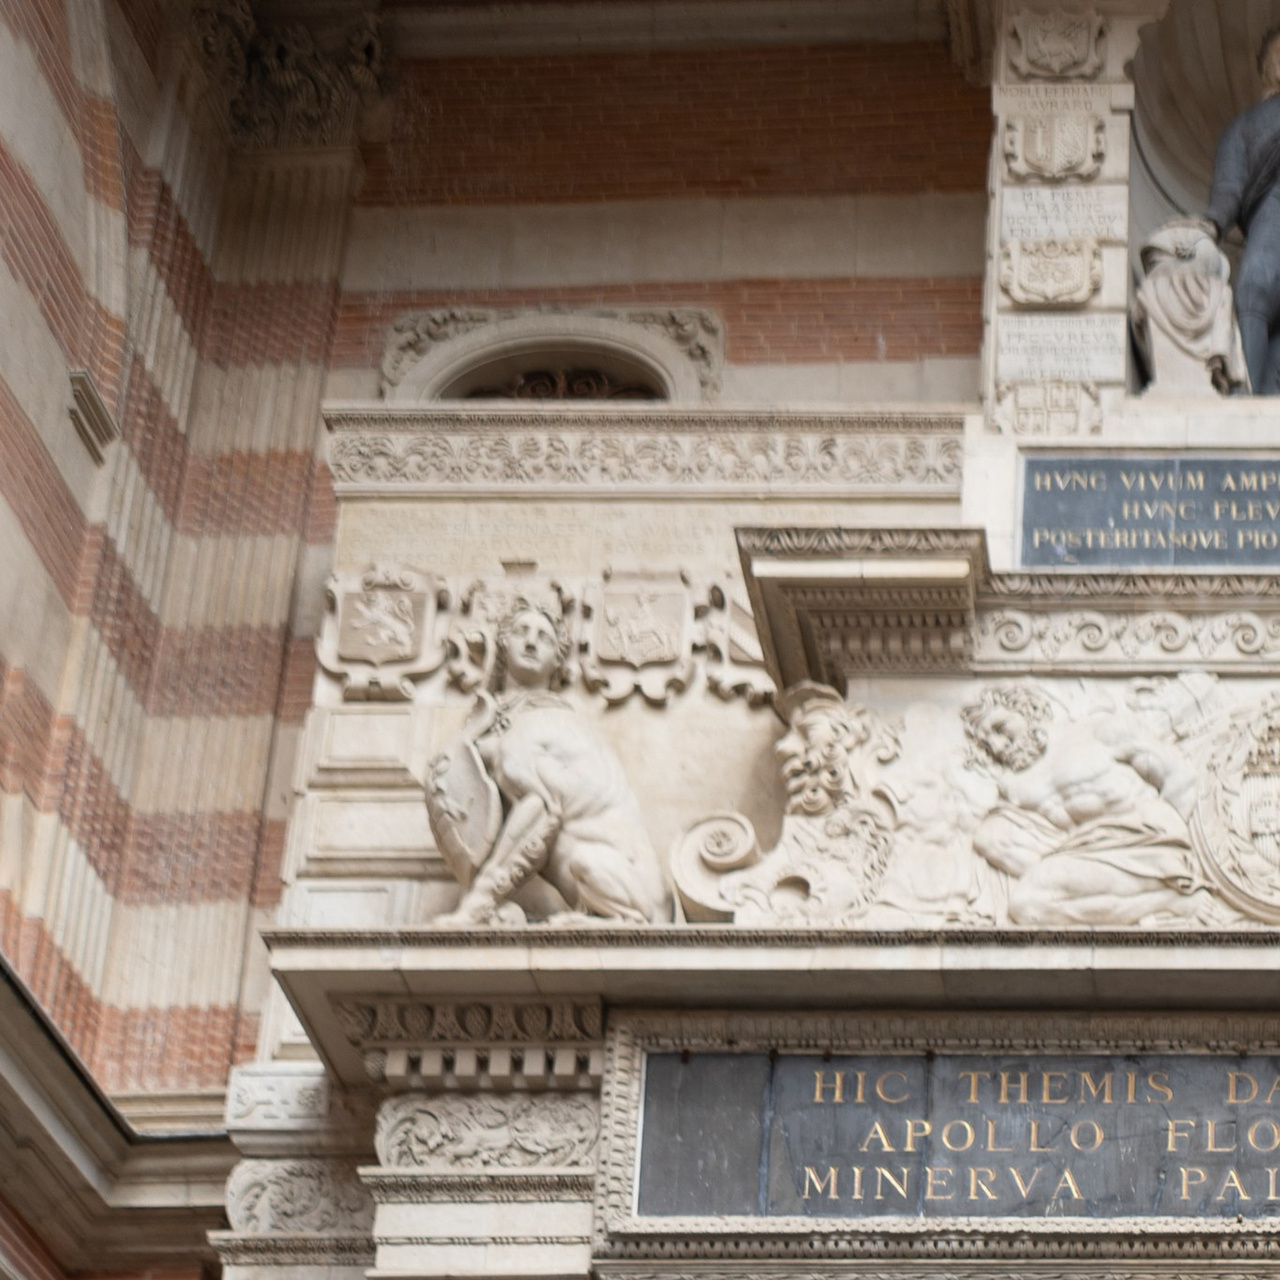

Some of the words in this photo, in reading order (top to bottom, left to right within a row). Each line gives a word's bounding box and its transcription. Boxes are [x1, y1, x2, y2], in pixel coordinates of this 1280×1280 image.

[1122, 500, 1197, 520] HVNC
[1237, 528, 1279, 549] PIO
[813, 1070, 910, 1104] HIC
[959, 1071, 1175, 1104] THEMIS
[859, 1118, 1105, 1153] APOLLO
[802, 1165, 1085, 1201] MINERVA
